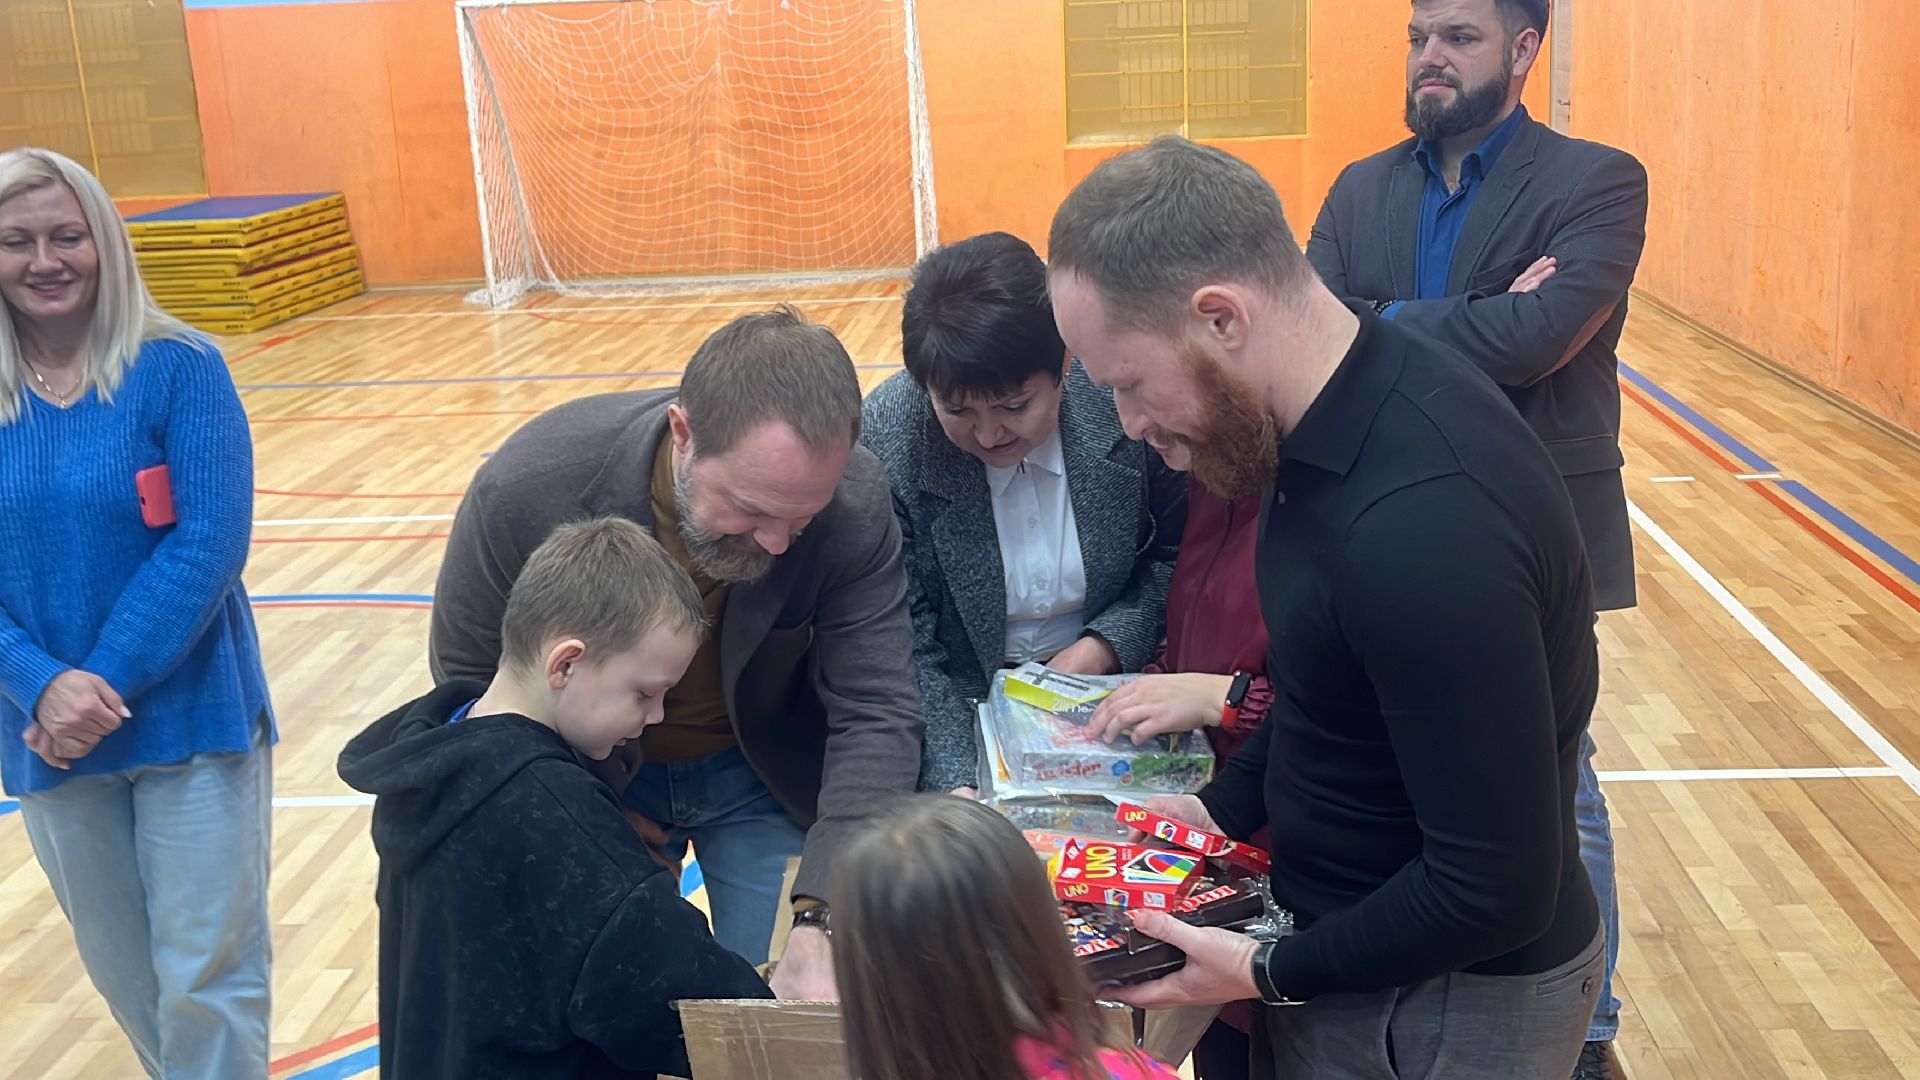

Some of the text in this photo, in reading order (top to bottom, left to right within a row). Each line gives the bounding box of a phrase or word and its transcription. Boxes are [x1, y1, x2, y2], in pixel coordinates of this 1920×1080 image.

[1124, 810, 1148, 823] UNO
[1084, 845, 1118, 879] UNO
[1063, 882, 1090, 898] UNO
